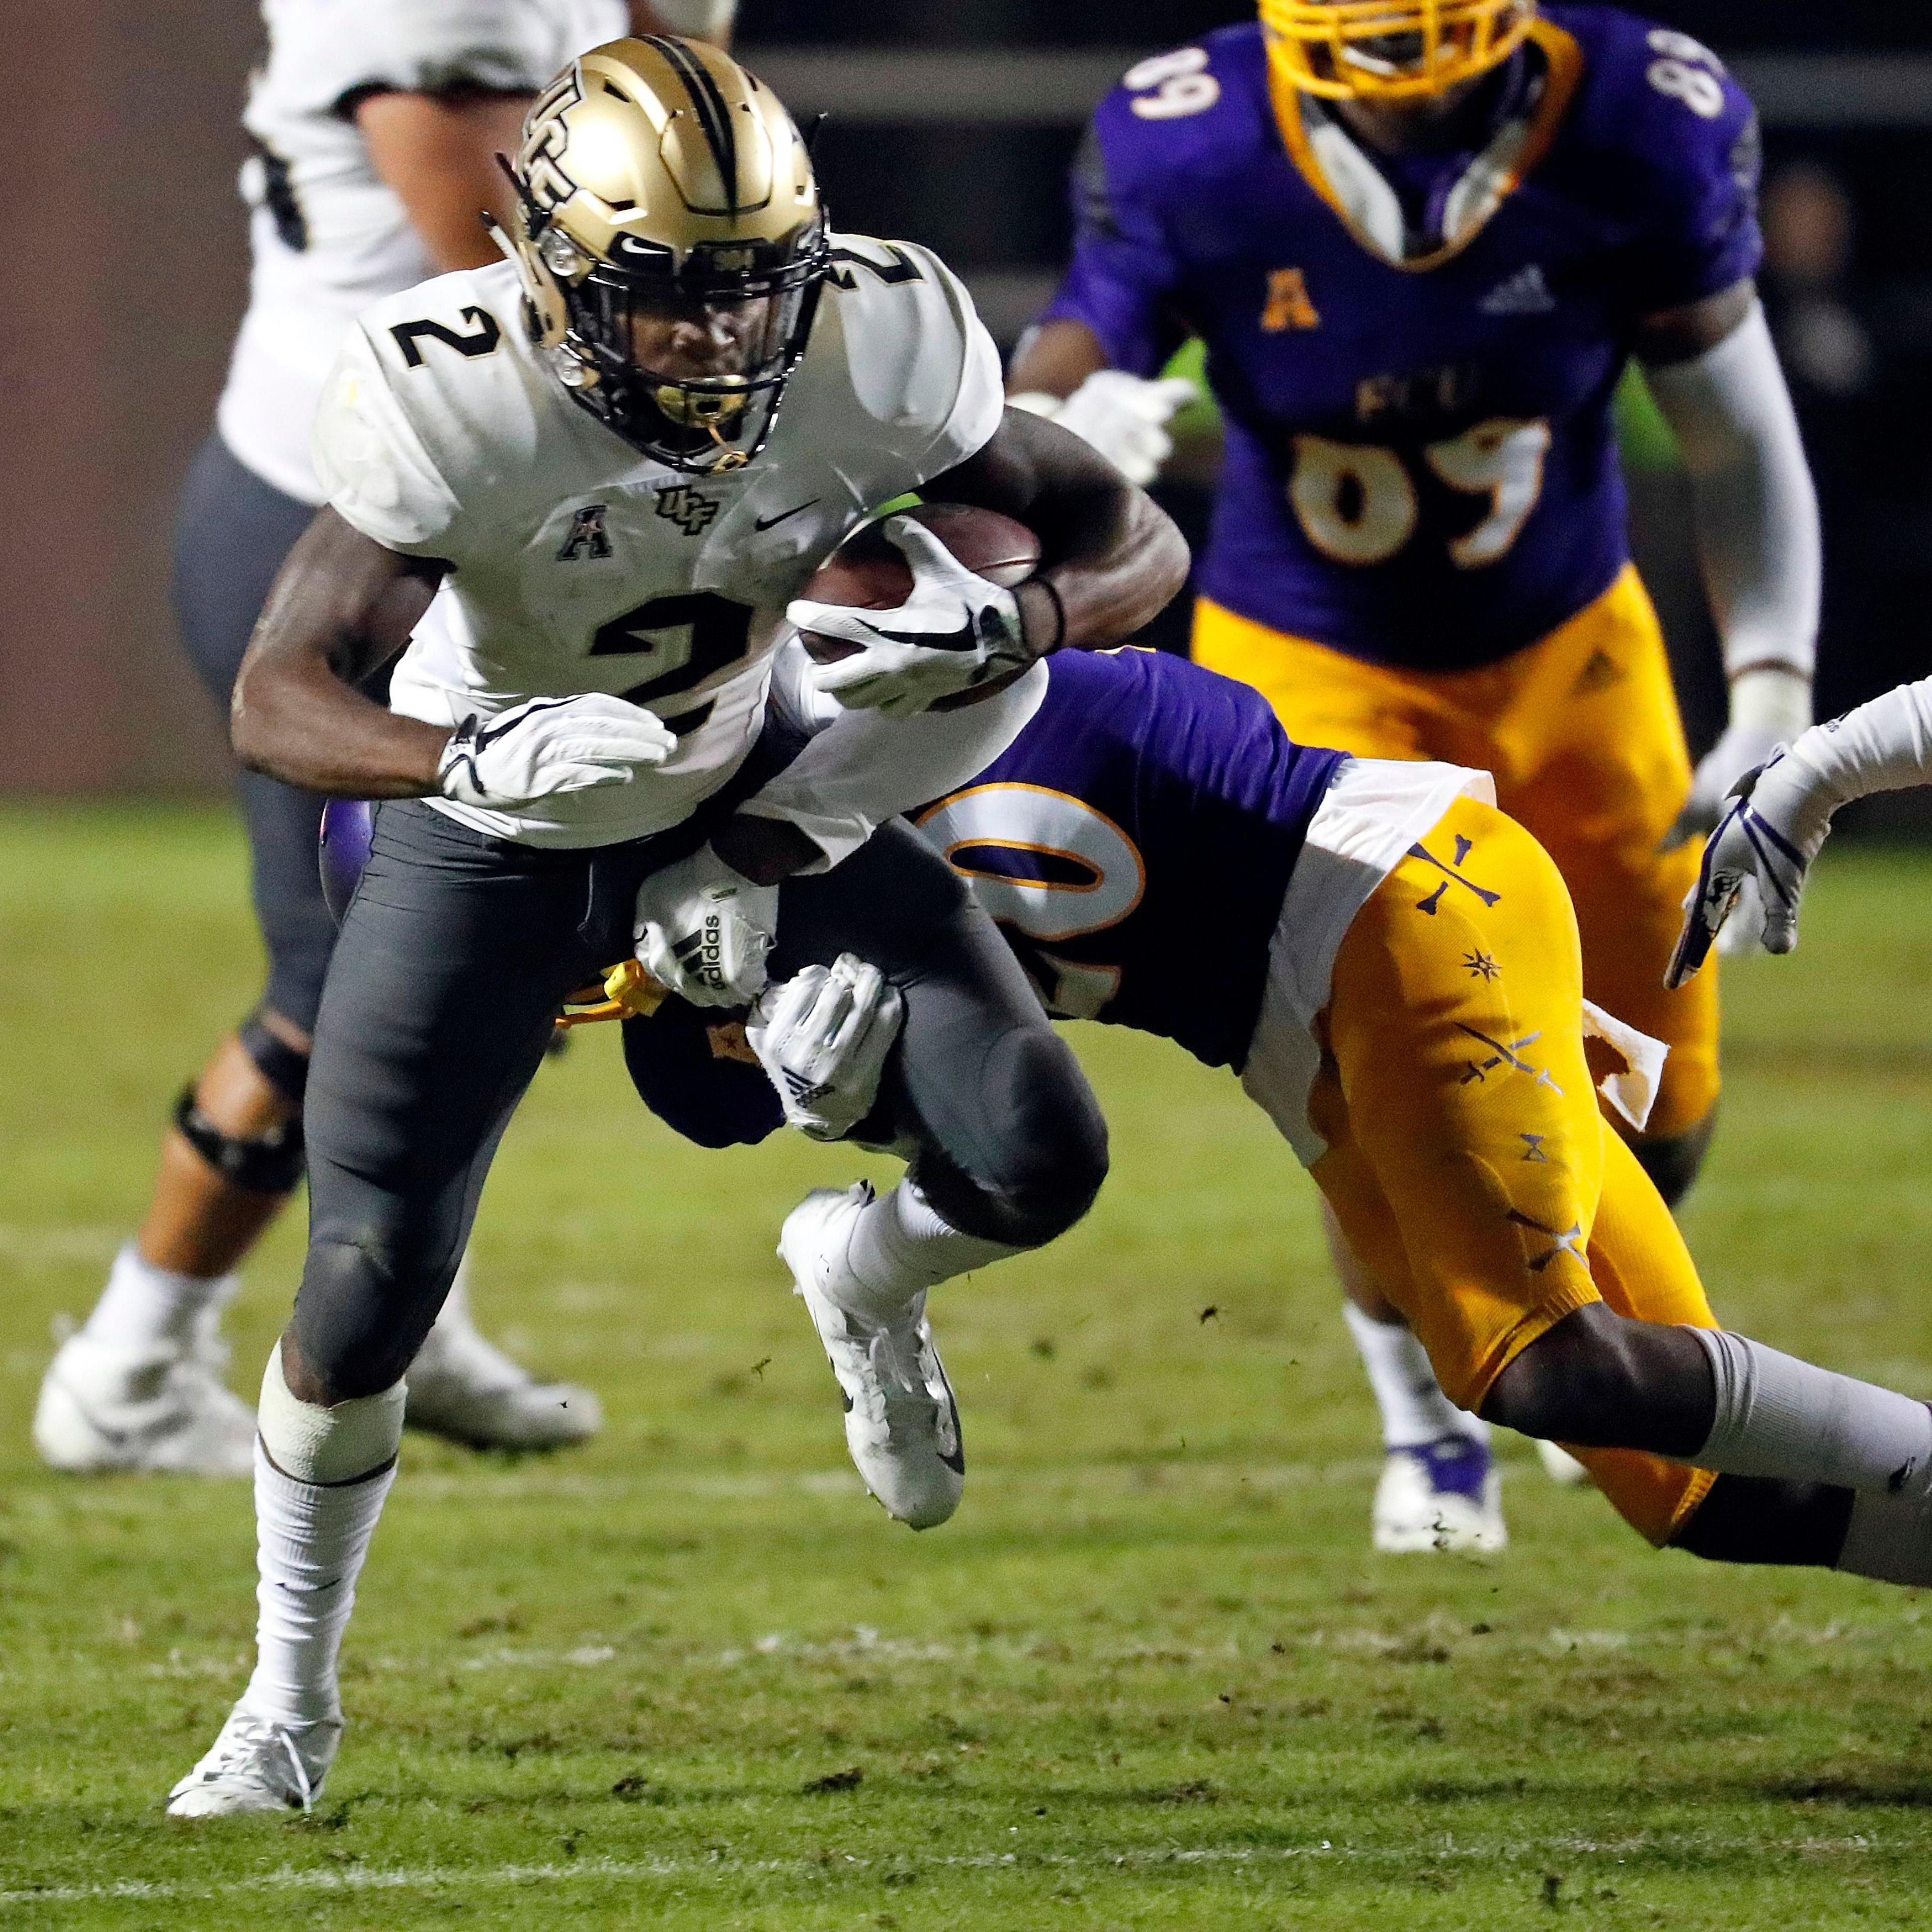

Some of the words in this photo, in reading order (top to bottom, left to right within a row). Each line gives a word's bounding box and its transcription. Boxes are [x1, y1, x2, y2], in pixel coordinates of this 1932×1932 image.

[388, 305, 502, 370] 2
[555, 505, 613, 561] A
[655, 485, 720, 536] UCF
[589, 591, 755, 737] 2
[702, 915, 725, 990] adidas
